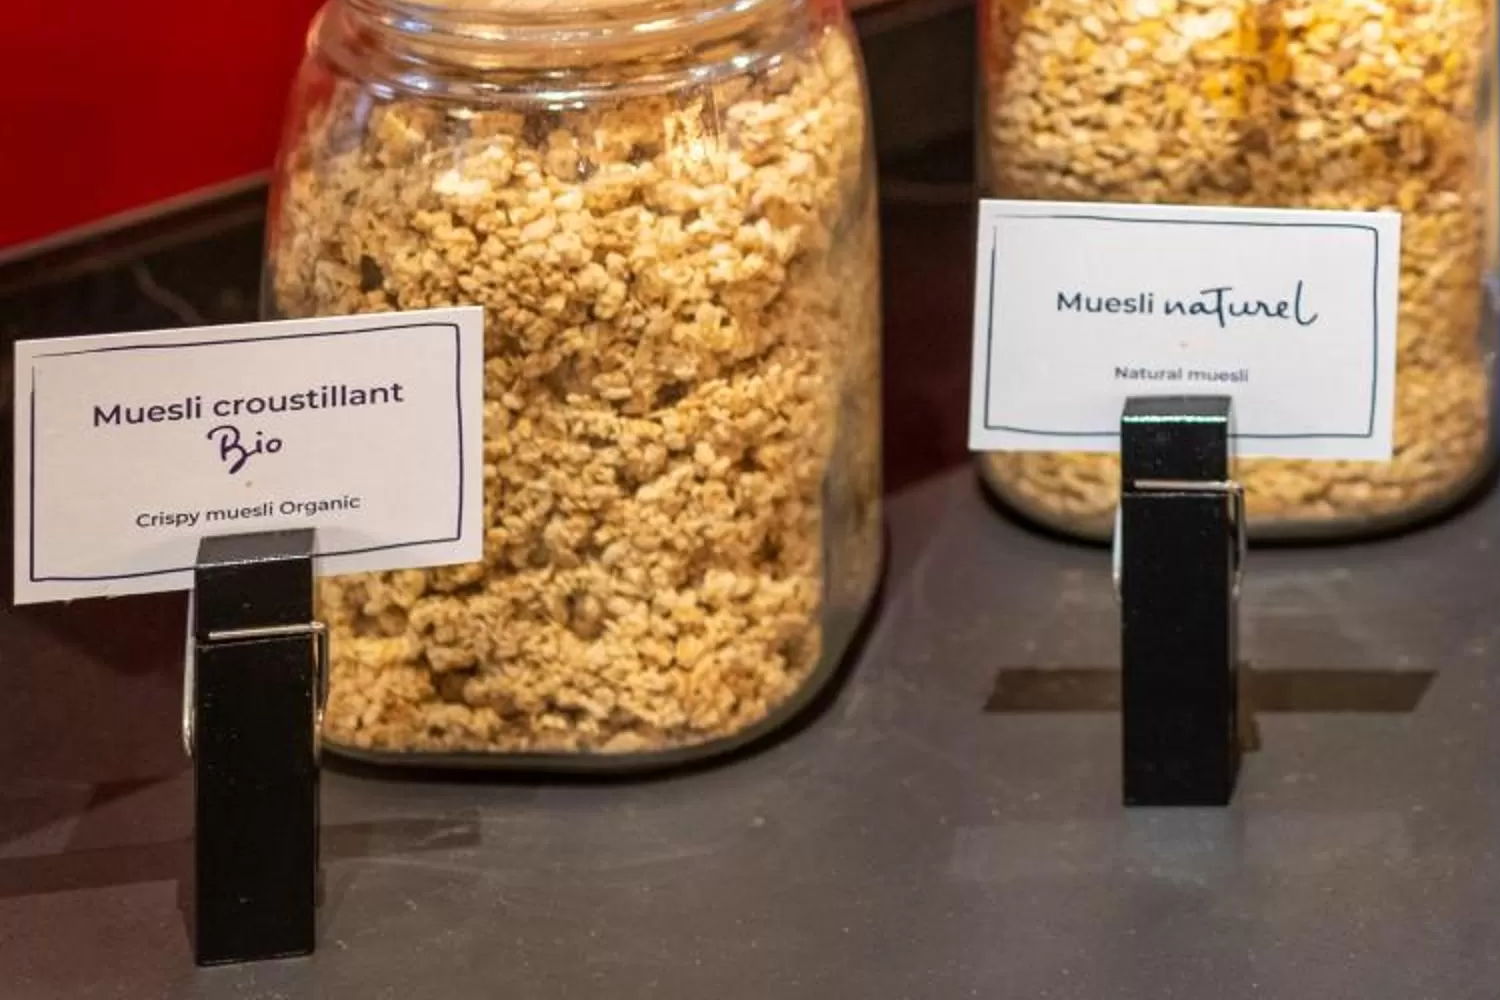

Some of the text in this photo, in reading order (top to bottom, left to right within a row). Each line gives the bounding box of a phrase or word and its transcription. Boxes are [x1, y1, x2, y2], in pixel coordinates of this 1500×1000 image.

[1056, 279, 1319, 329] Muesli naturel
[1114, 366, 1249, 383] Natural muesli
[92, 382, 405, 428] Muesli croustillant
[206, 424, 283, 475] Bio
[135, 494, 361, 528] Crispy muesli Organic
